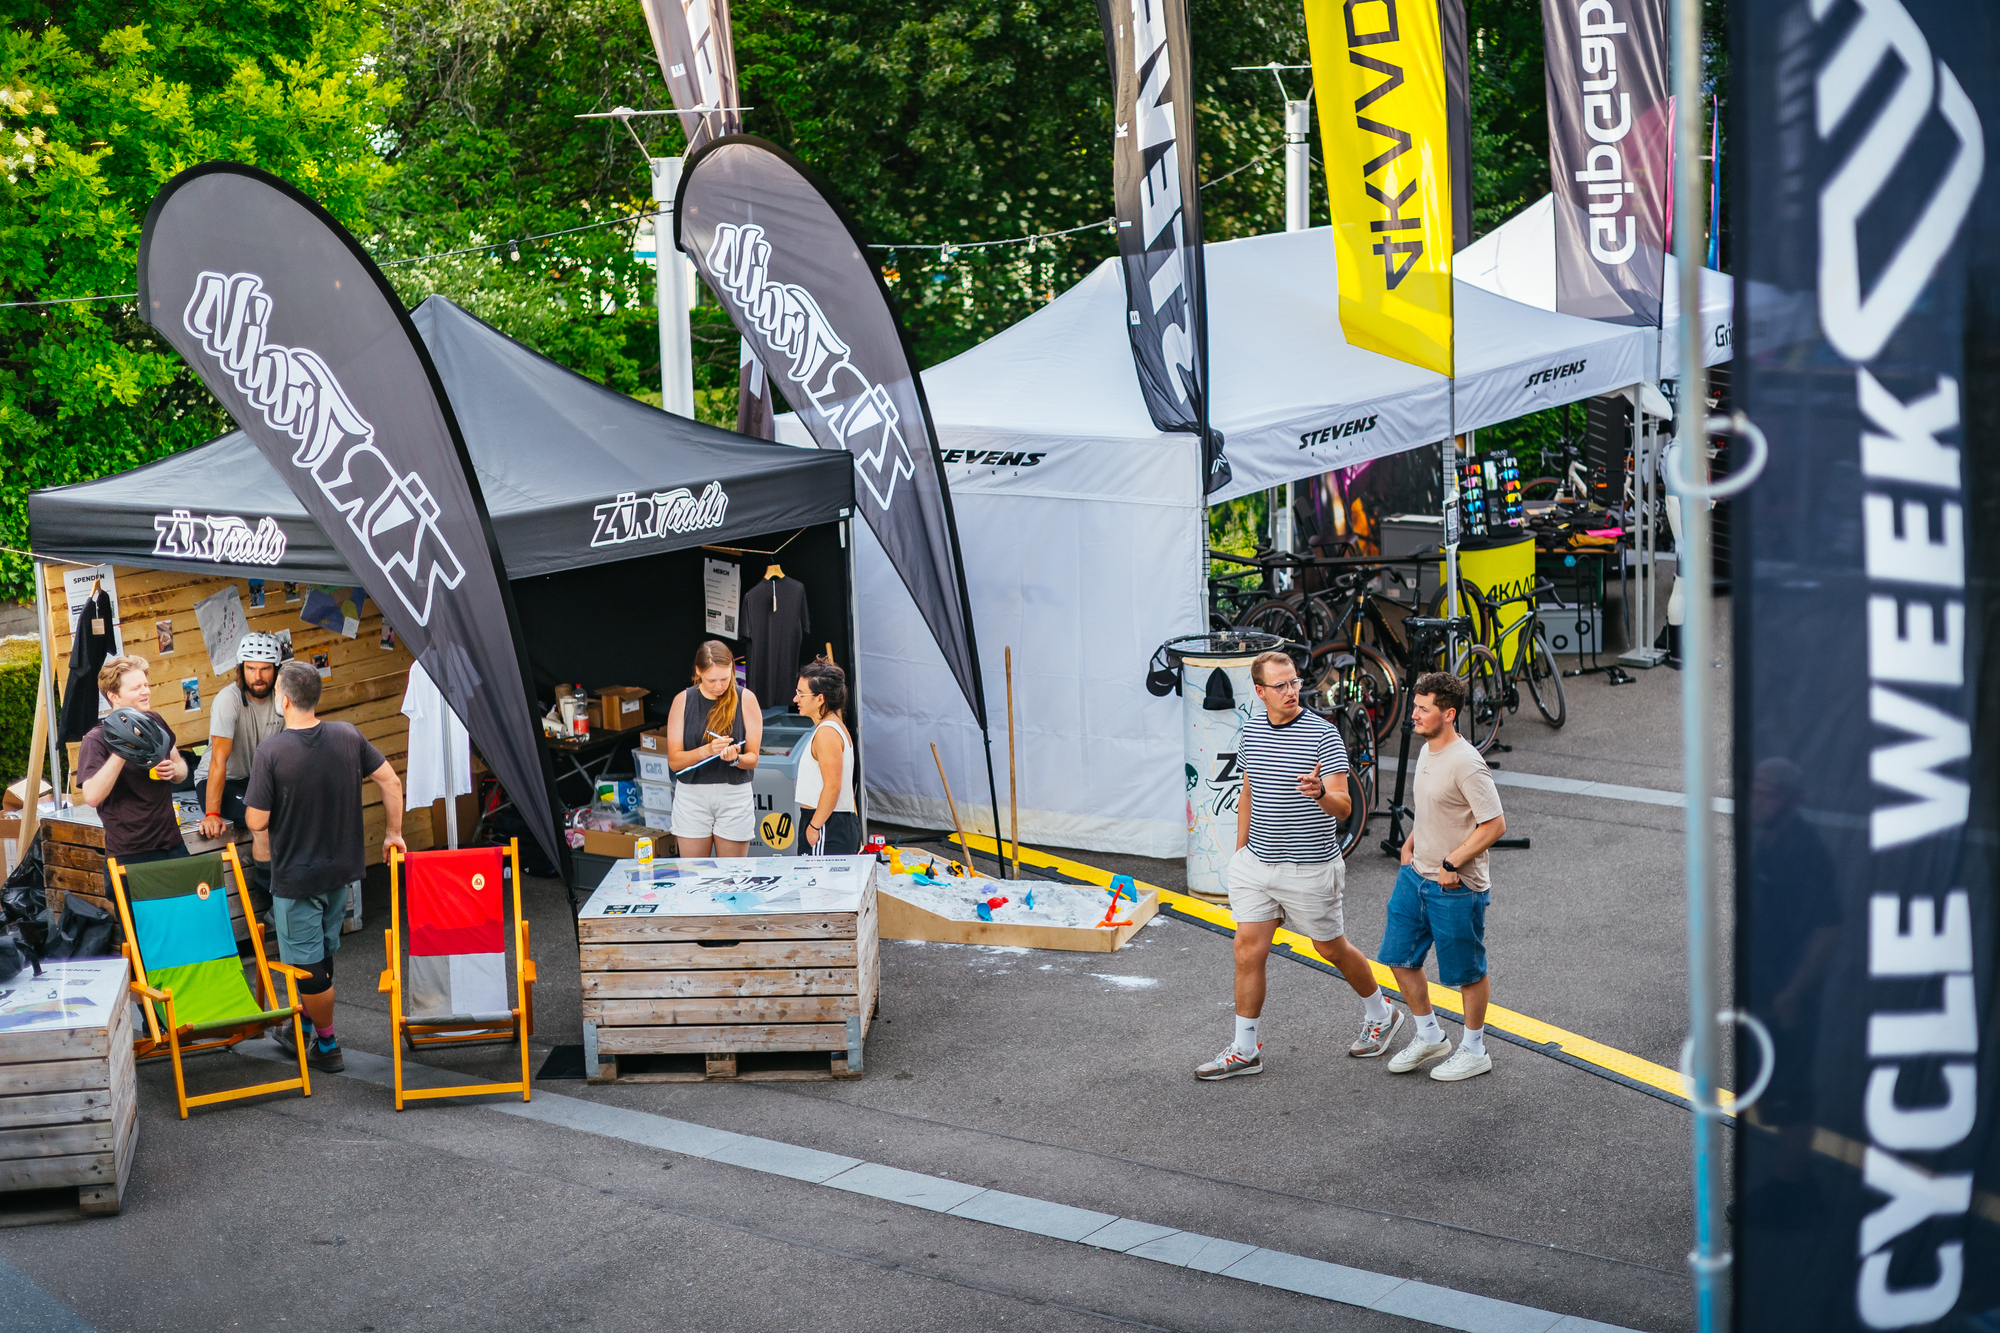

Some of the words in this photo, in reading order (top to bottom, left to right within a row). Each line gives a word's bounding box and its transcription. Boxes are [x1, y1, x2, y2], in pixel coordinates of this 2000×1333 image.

[1525, 359, 1587, 389] STEVENS
[1299, 414, 1379, 450] STEVENS
[73, 573, 105, 585] SPENDEN
[713, 567, 730, 576] MERCH
[1861, 369, 1973, 851] WEEK
[1856, 890, 1978, 1331] CYCLE
